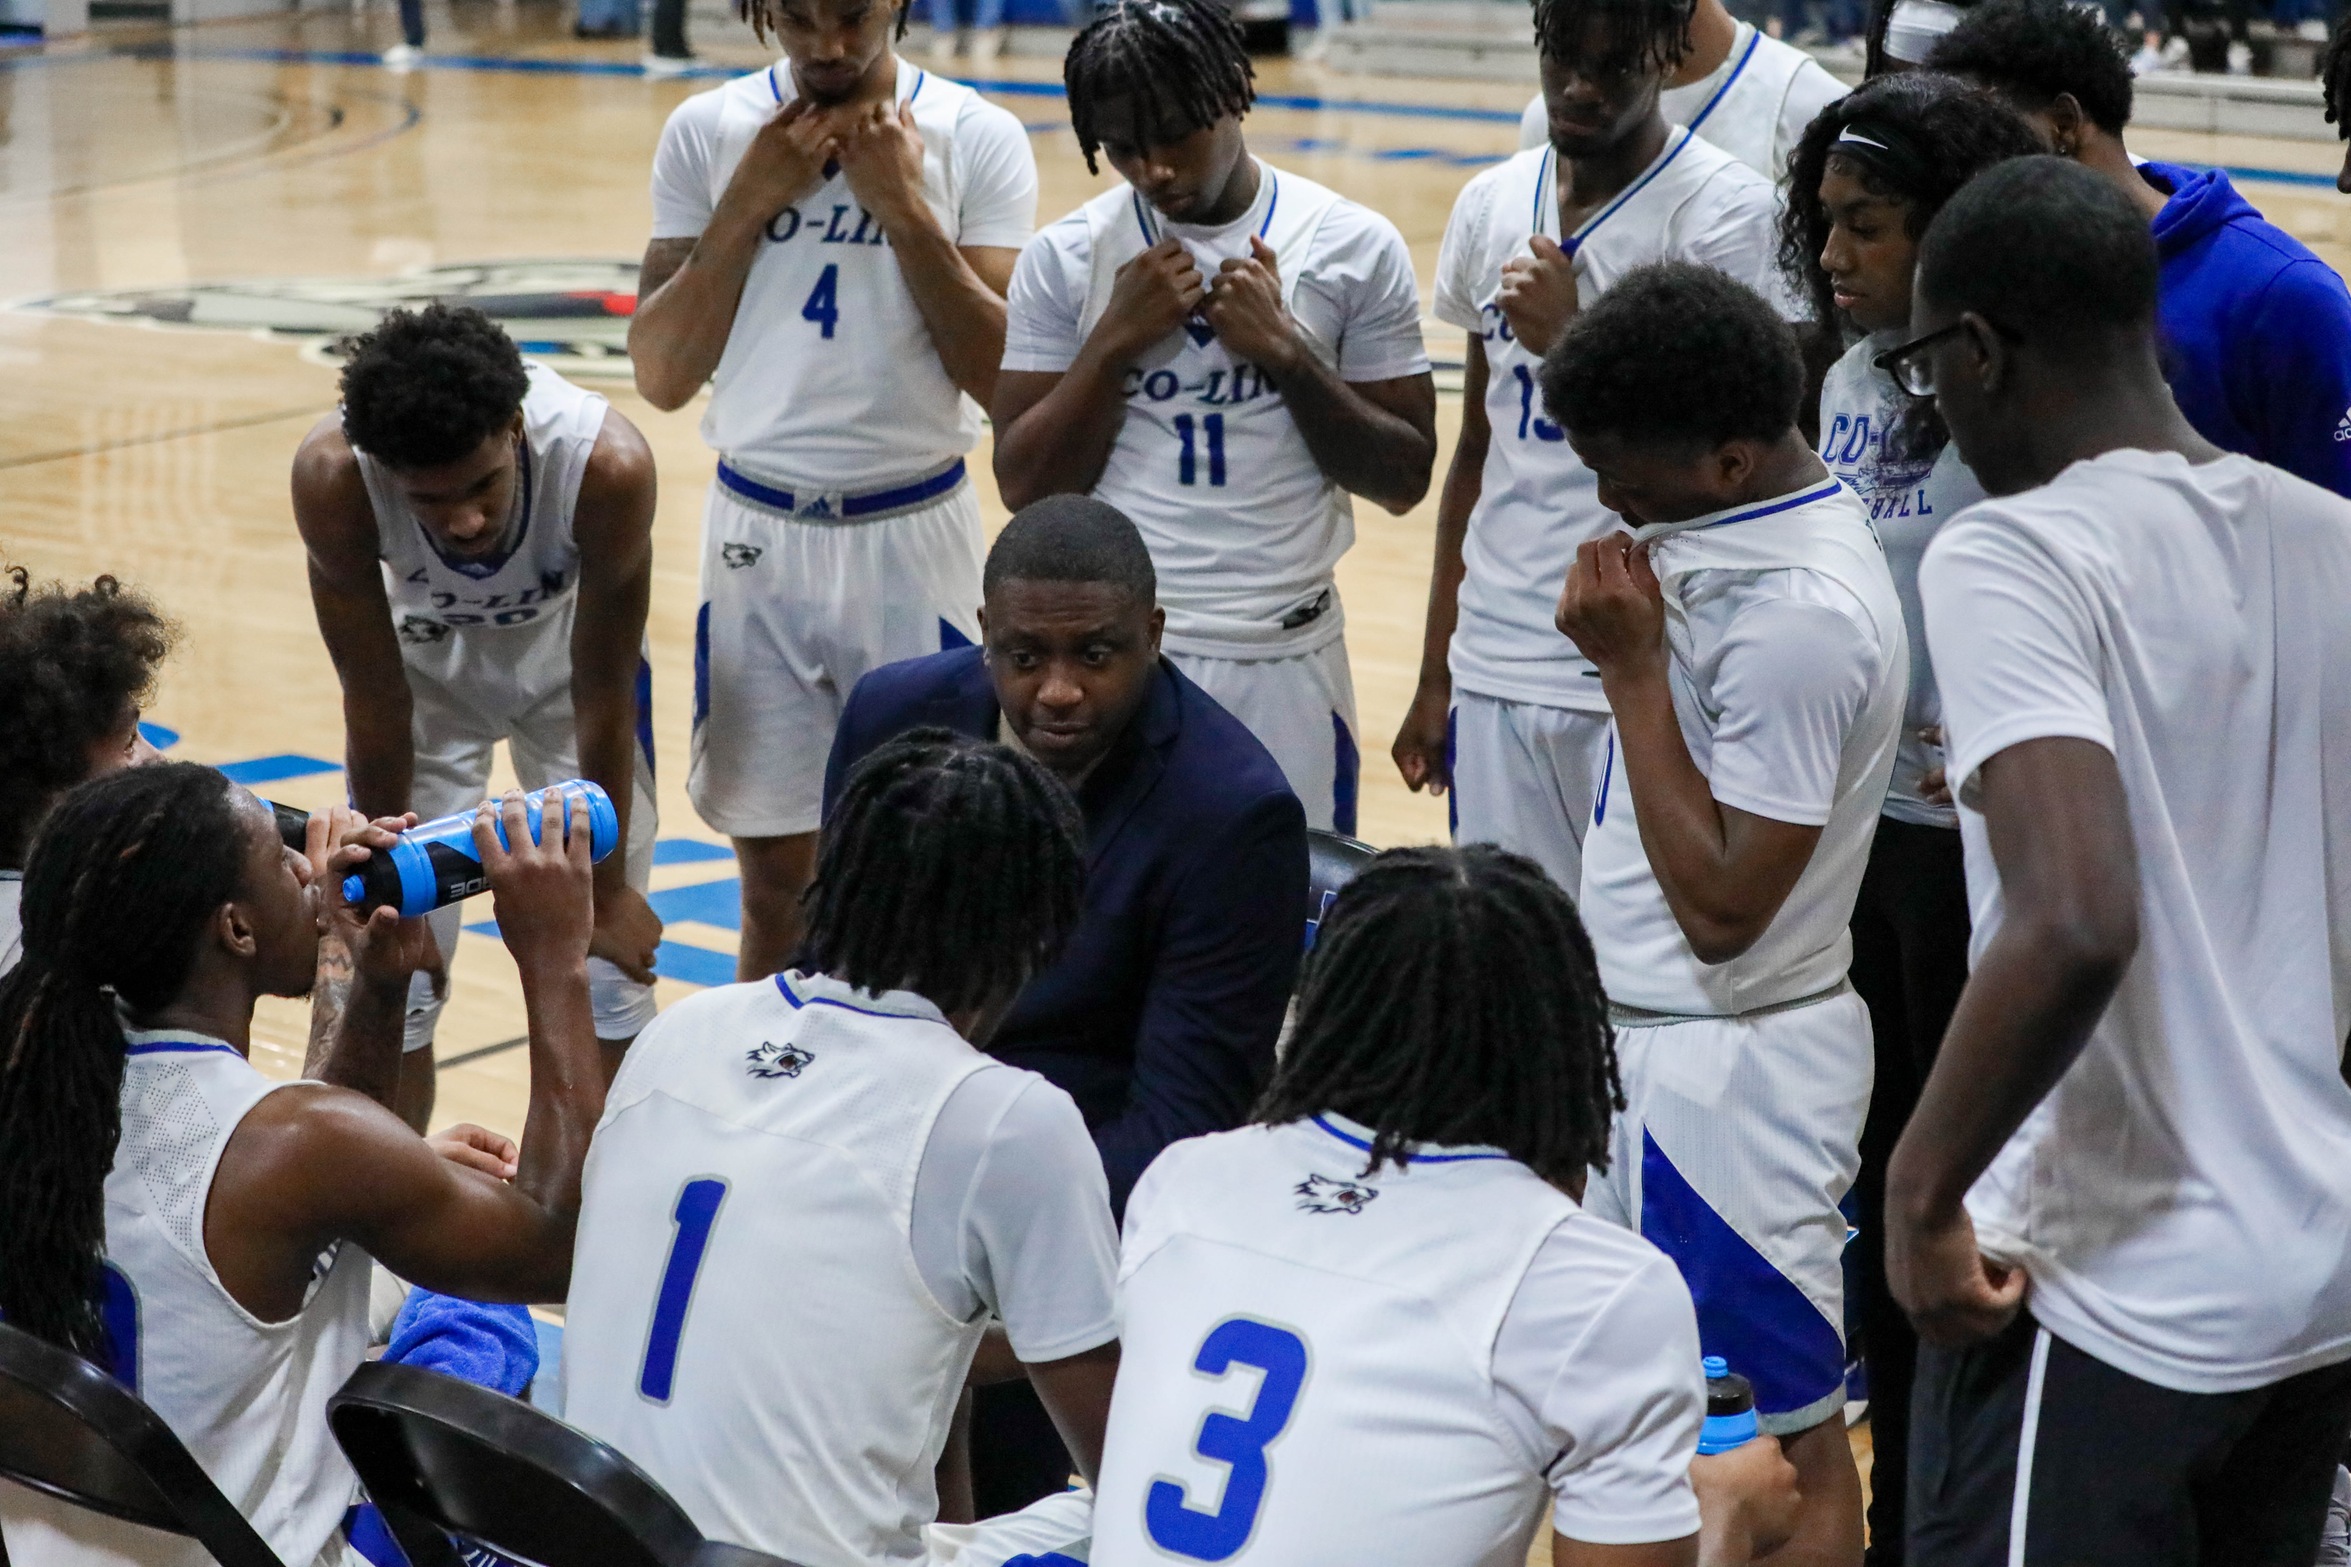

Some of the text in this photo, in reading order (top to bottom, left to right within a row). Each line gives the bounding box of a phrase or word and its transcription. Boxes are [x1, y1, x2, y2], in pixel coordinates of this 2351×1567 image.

[766, 204, 884, 244] O-LI
[802, 263, 838, 339] 4
[1174, 412, 1226, 486] 11
[636, 1173, 732, 1408] 1
[1141, 1312, 1314, 1563] 3
